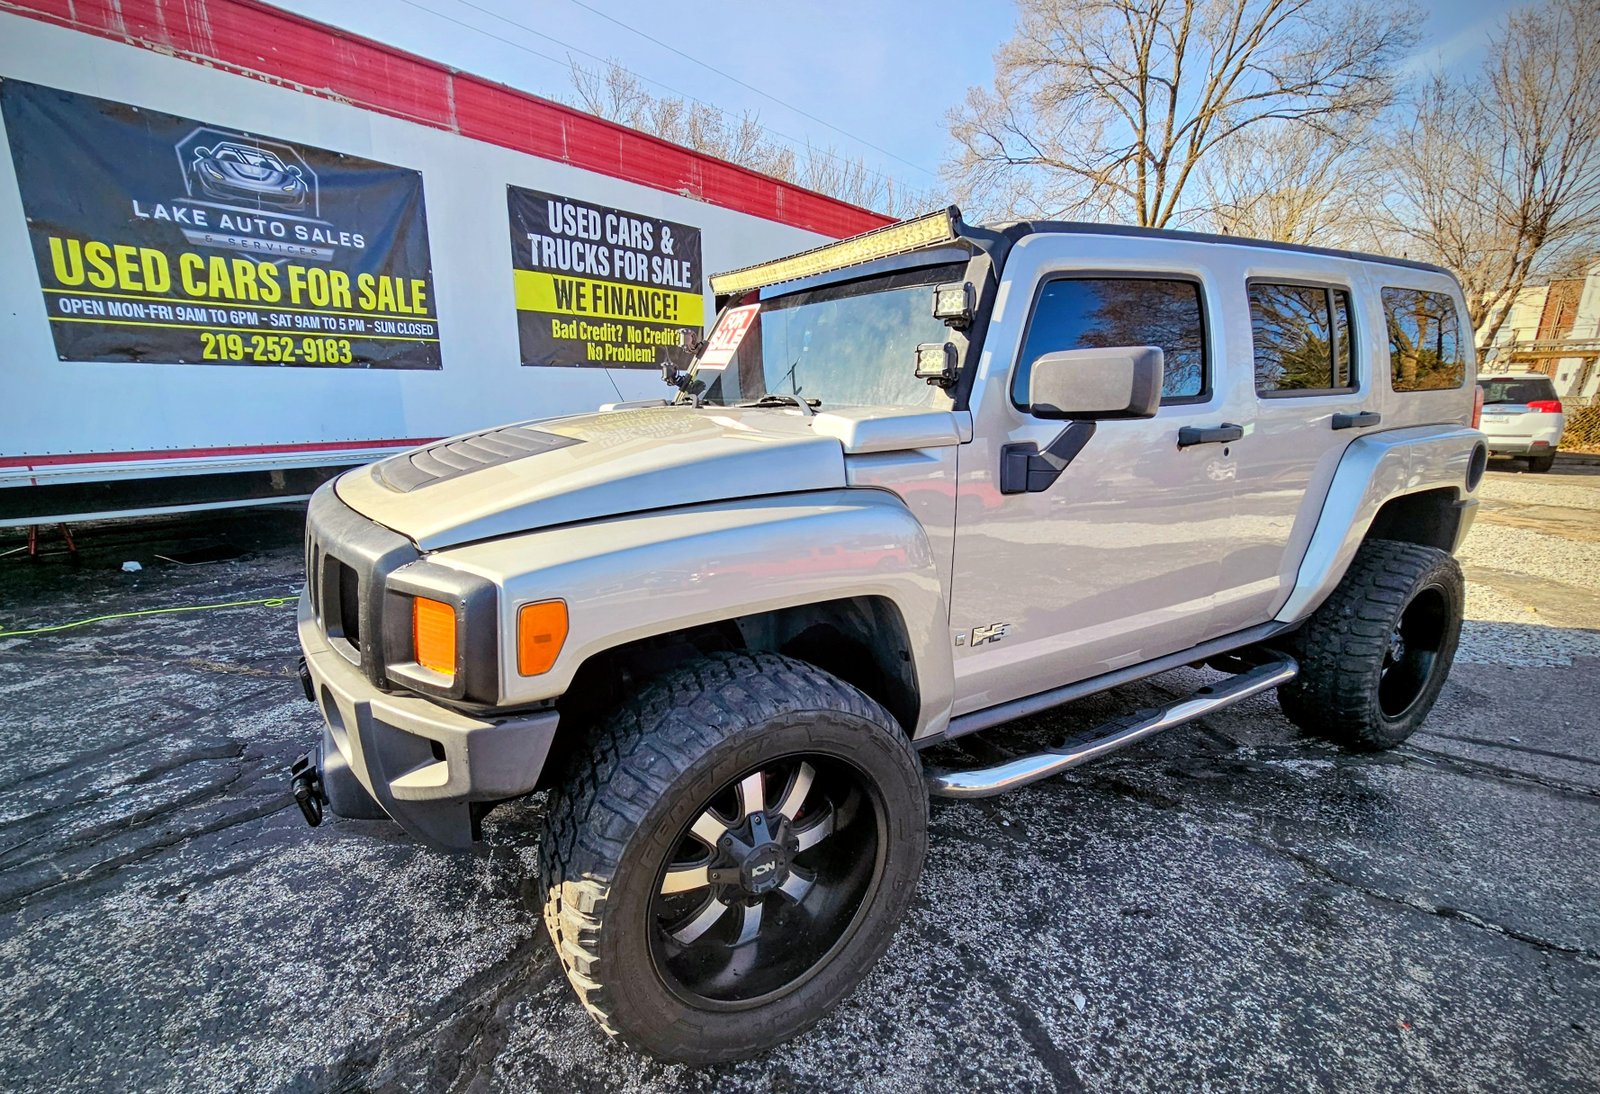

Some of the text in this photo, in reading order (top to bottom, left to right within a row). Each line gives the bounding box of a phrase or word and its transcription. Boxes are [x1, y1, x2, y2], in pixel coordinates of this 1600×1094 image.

[133, 200, 366, 249] LAKE AUTO SALES
[547, 200, 675, 256] USED CARS &
[204, 234, 319, 257] & SERVICES
[527, 233, 692, 289] TRUCKS FOR SALE
[48, 236, 428, 315] USED CARS FOR SALE
[553, 277, 679, 321] WE FINANCE!
[59, 298, 105, 316] OPEN
[107, 301, 174, 320] MON-FRI
[176, 306, 207, 322] 9AM
[208, 309, 228, 324] TO
[230, 310, 259, 326] 6PM
[270, 313, 293, 327] SAT
[294, 315, 320, 330] 9AM
[321, 317, 337, 331] TO
[339, 318, 347, 331] 5
[348, 319, 365, 332] PM
[374, 321, 396, 334] SUN
[397, 323, 434, 336] CLOSED
[551, 319, 680, 346] Bad Credit? No Credit?
[722, 310, 750, 330] FOR
[200, 332, 353, 365] 219-252-9183
[586, 342, 656, 363] No Problem!
[751, 860, 776, 878] ION
